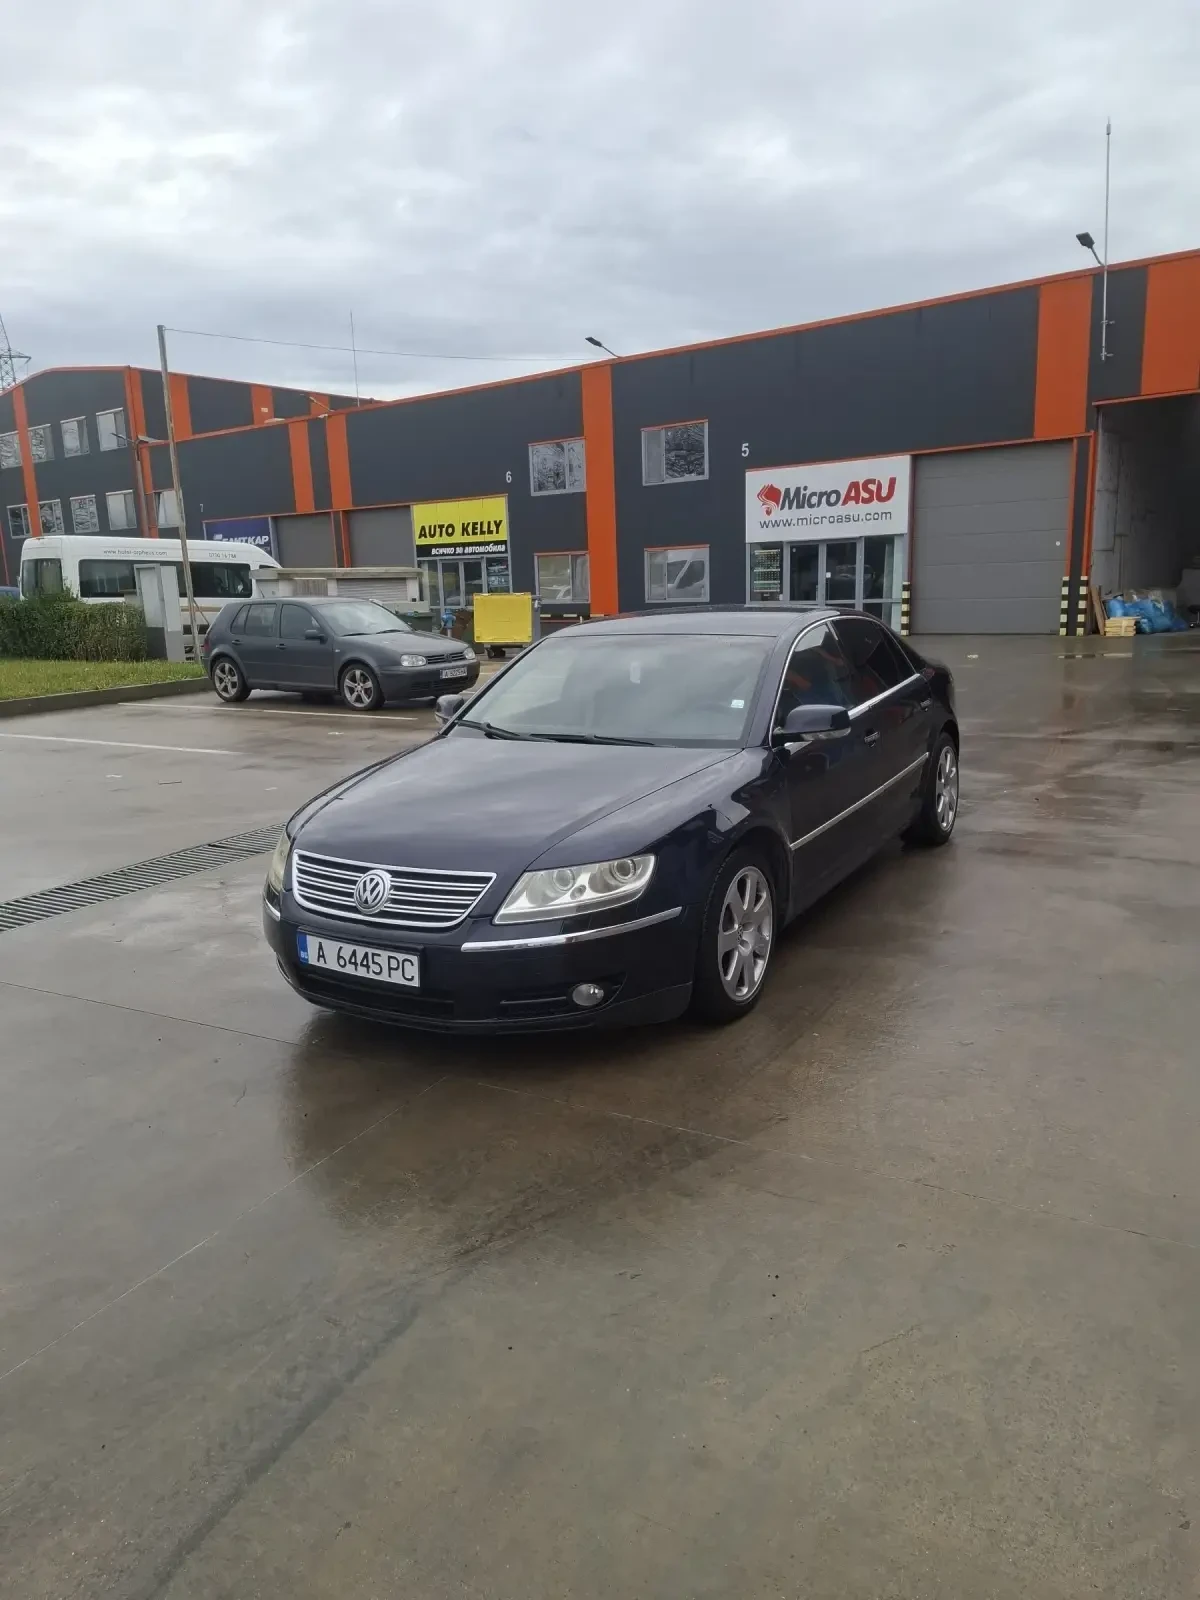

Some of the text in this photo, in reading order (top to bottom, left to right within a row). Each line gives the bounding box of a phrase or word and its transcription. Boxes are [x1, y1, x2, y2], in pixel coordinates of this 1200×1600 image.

[741, 443, 750, 457] 5
[505, 471, 512, 483] 6
[418, 519, 503, 539] AUTO KELLY
[759, 510, 893, 529] www.microasu.com
[316, 941, 327, 965] A
[336, 946, 383, 976] 6445
